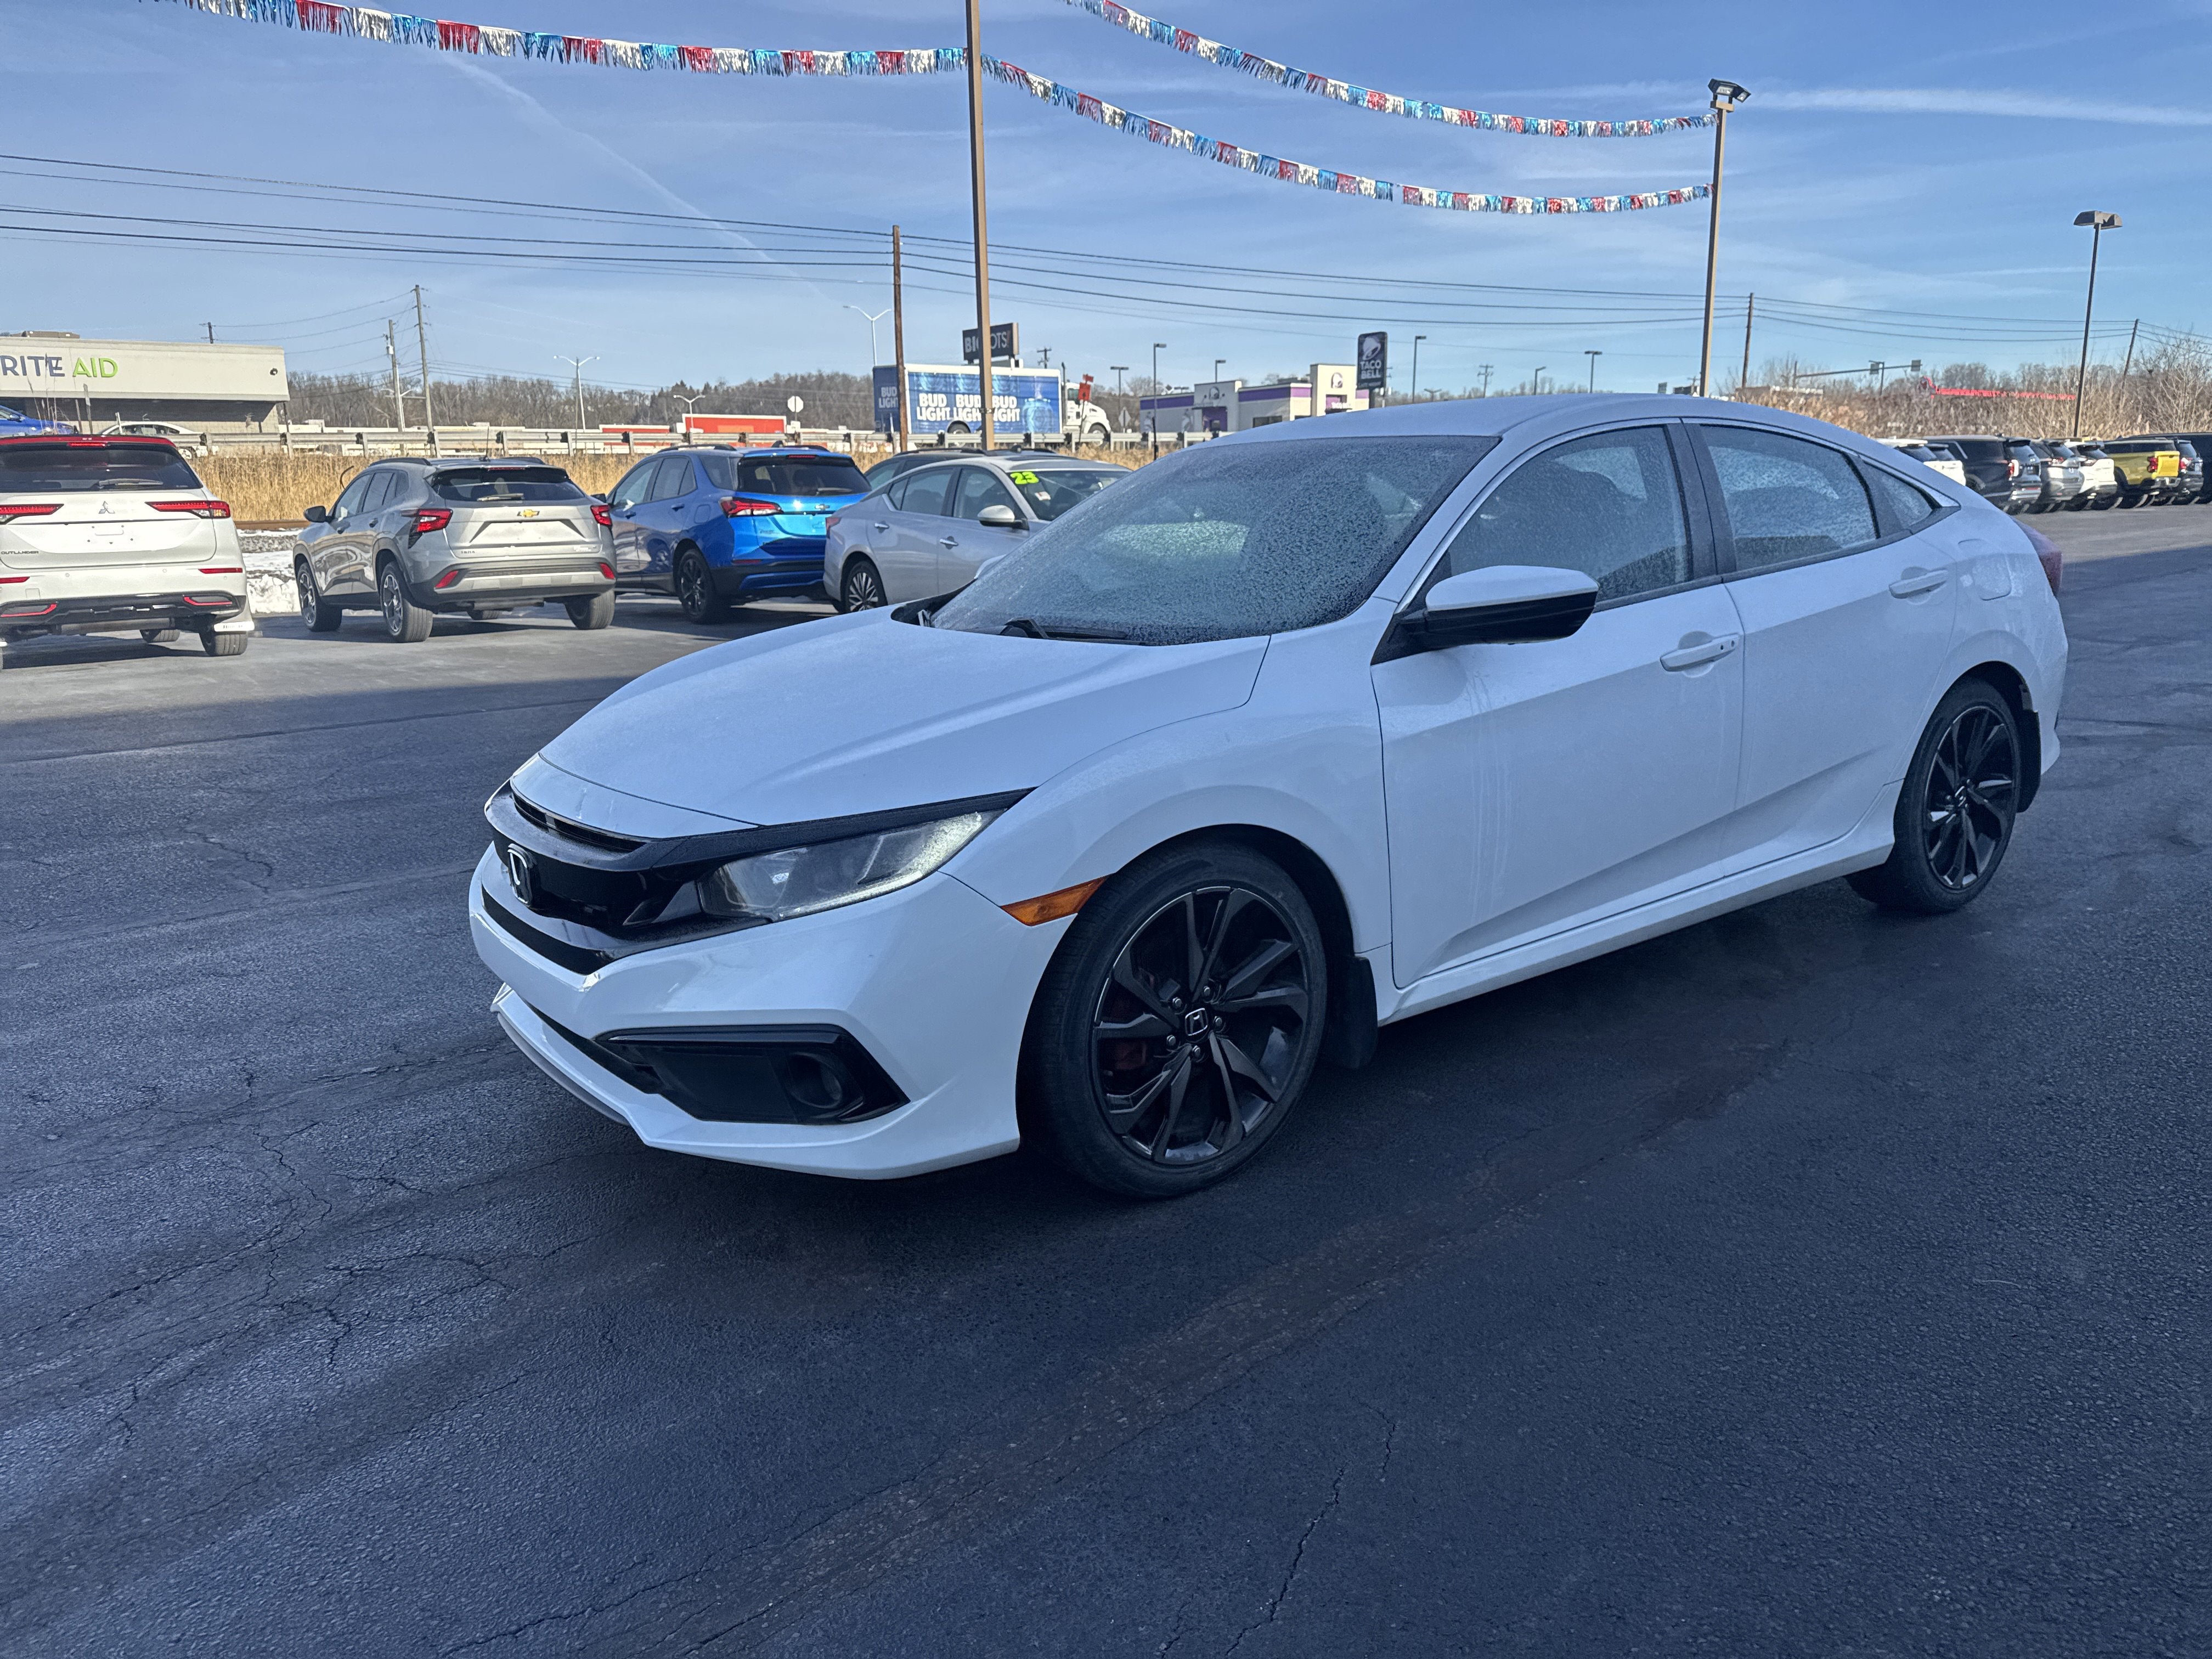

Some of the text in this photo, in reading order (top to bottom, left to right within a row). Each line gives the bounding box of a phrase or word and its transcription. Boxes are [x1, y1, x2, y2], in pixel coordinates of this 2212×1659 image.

[991, 330, 1011, 349] OTS!
[0, 356, 118, 377] RITE AID
[1360, 360, 1382, 370] TACO
[1361, 369, 1381, 380] BELL
[881, 386, 898, 398] BUD
[919, 393, 947, 407] BUD
[992, 396, 1017, 408] BUD
[916, 407, 951, 421] LIGHT
[953, 407, 982, 422] LIGH
[993, 408, 1020, 422] IGHT
[1010, 471, 1039, 484] 23
